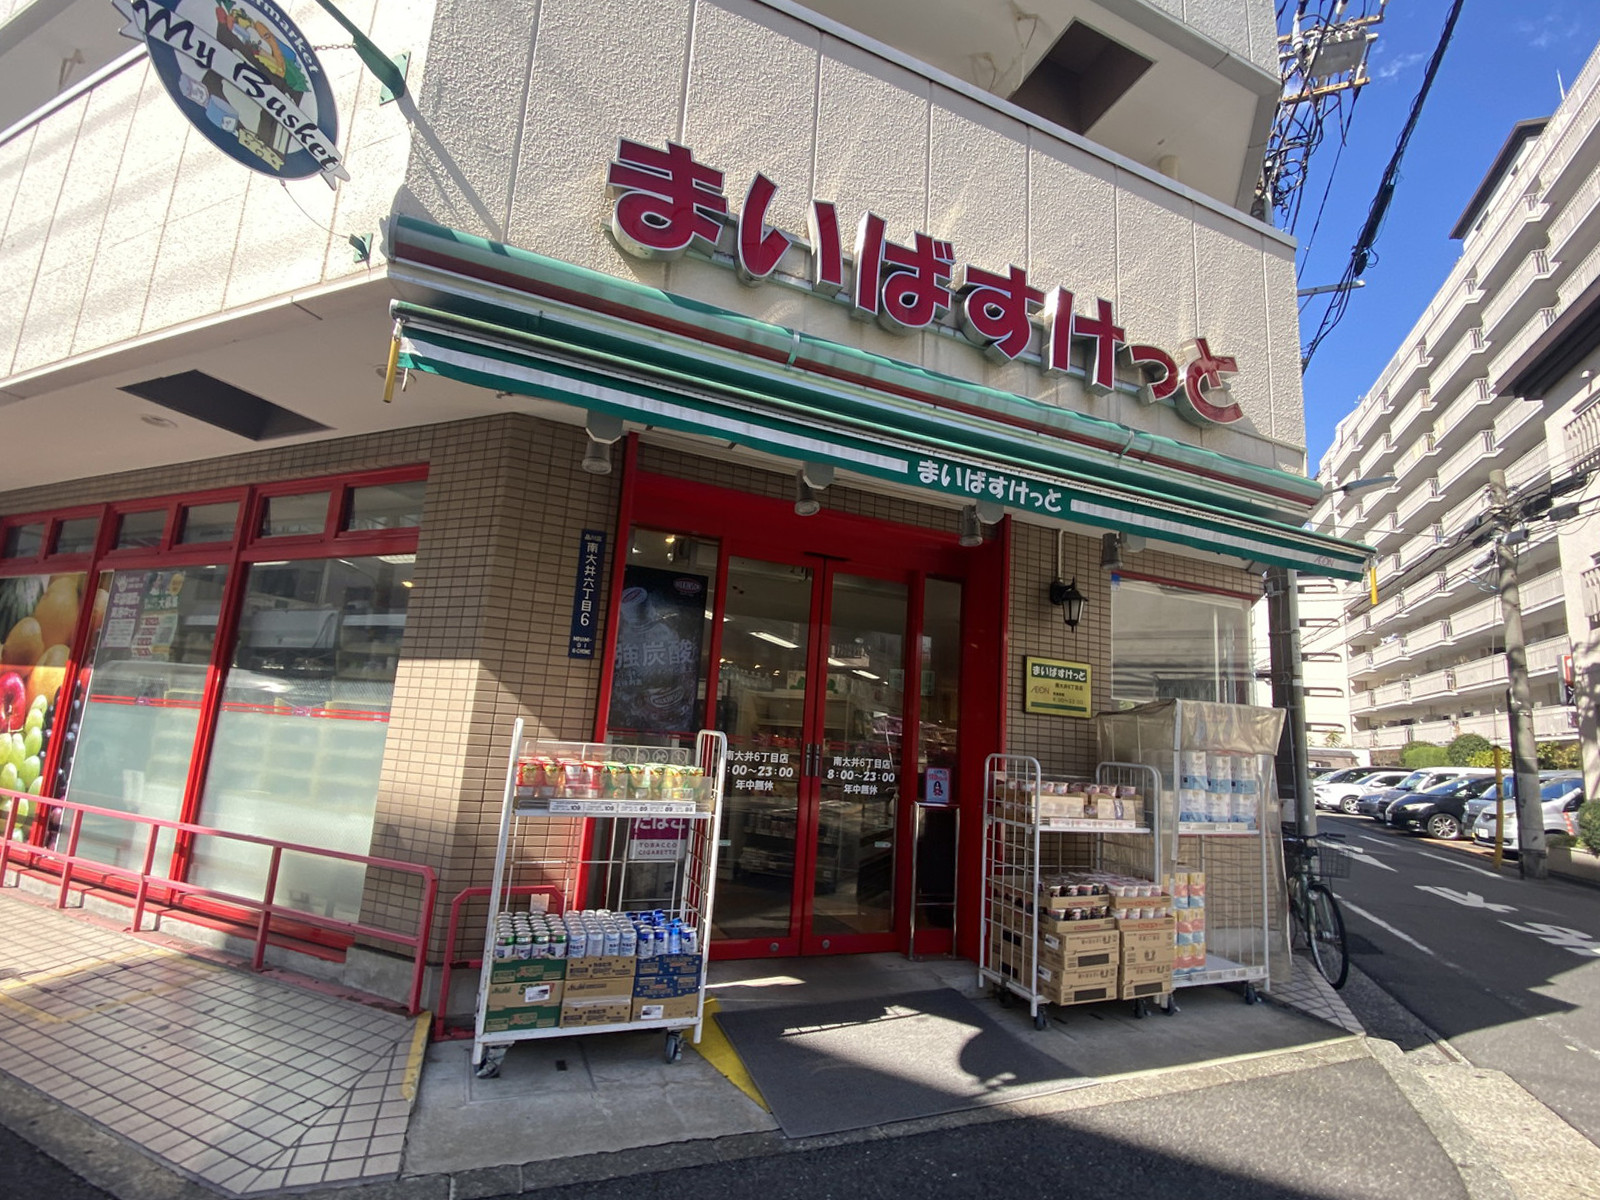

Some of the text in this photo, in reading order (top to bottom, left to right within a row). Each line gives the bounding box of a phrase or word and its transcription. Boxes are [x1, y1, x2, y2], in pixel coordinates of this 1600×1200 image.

[133, 0, 340, 171] My Basket
[605, 137, 1243, 427] まいばすけっと
[917, 459, 1062, 513] まいばすけっと
[580, 542, 599, 626] 南大井六丁目6
[615, 639, 694, 669] 強炭酸
[1033, 666, 1086, 681] まいばすけっと
[833, 756, 890, 770] 南大井6丁目店
[735, 778, 775, 792] 年中無休
[843, 783, 879, 796] 年中無休
